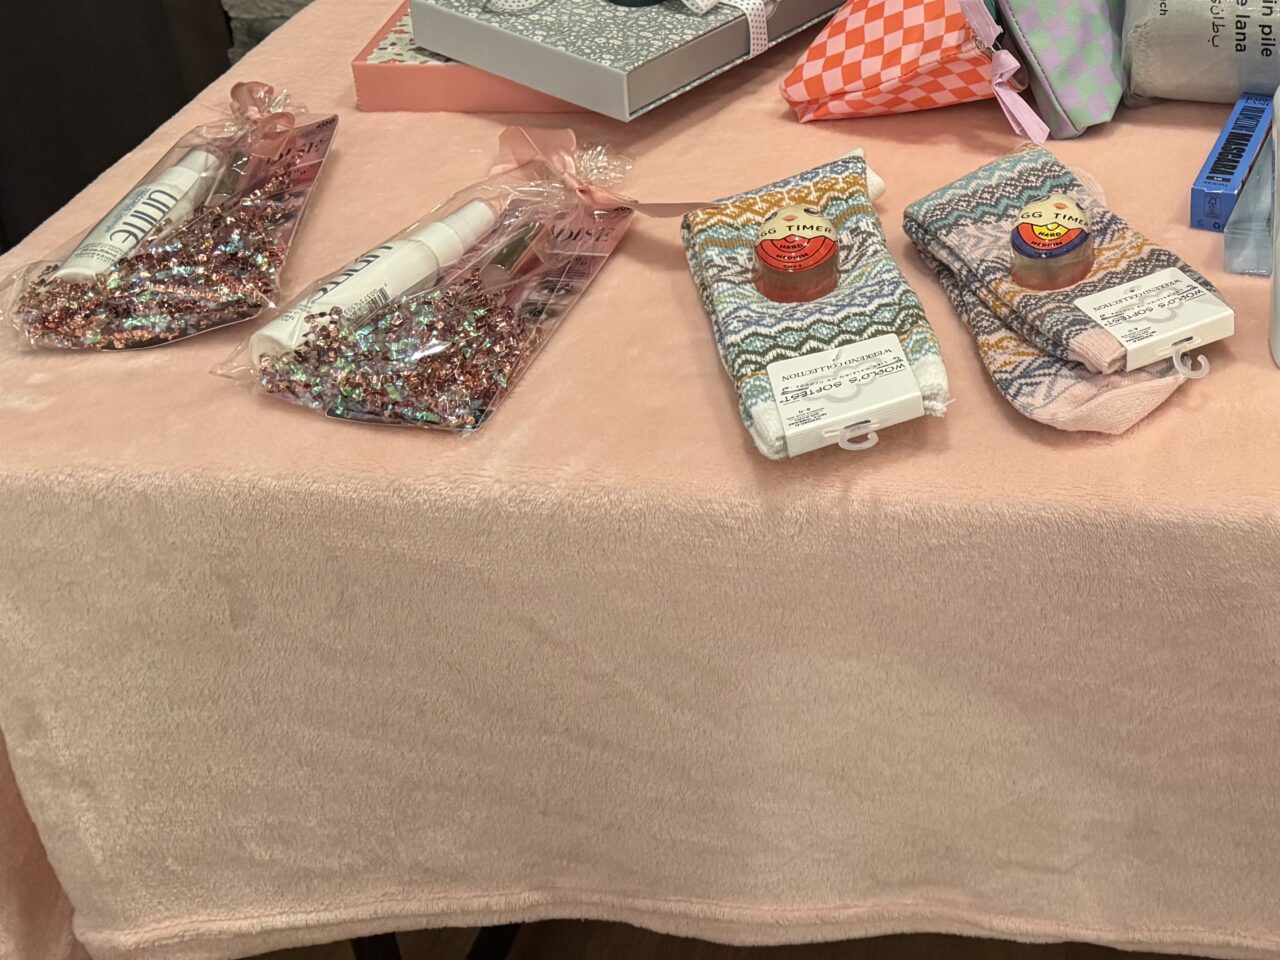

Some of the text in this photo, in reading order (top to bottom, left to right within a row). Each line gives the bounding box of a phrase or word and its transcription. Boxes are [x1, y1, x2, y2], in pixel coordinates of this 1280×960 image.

[1262, 0, 1277, 17] in
[1235, 14, 1251, 53] lana
[1259, 24, 1276, 57] pile
[786, 225, 832, 233] TIMER
[1054, 212, 1089, 227] TIMER
[782, 348, 893, 382] WEEKEND COLLECTION
[784, 363, 906, 403] WORLD'S SOFTEST
